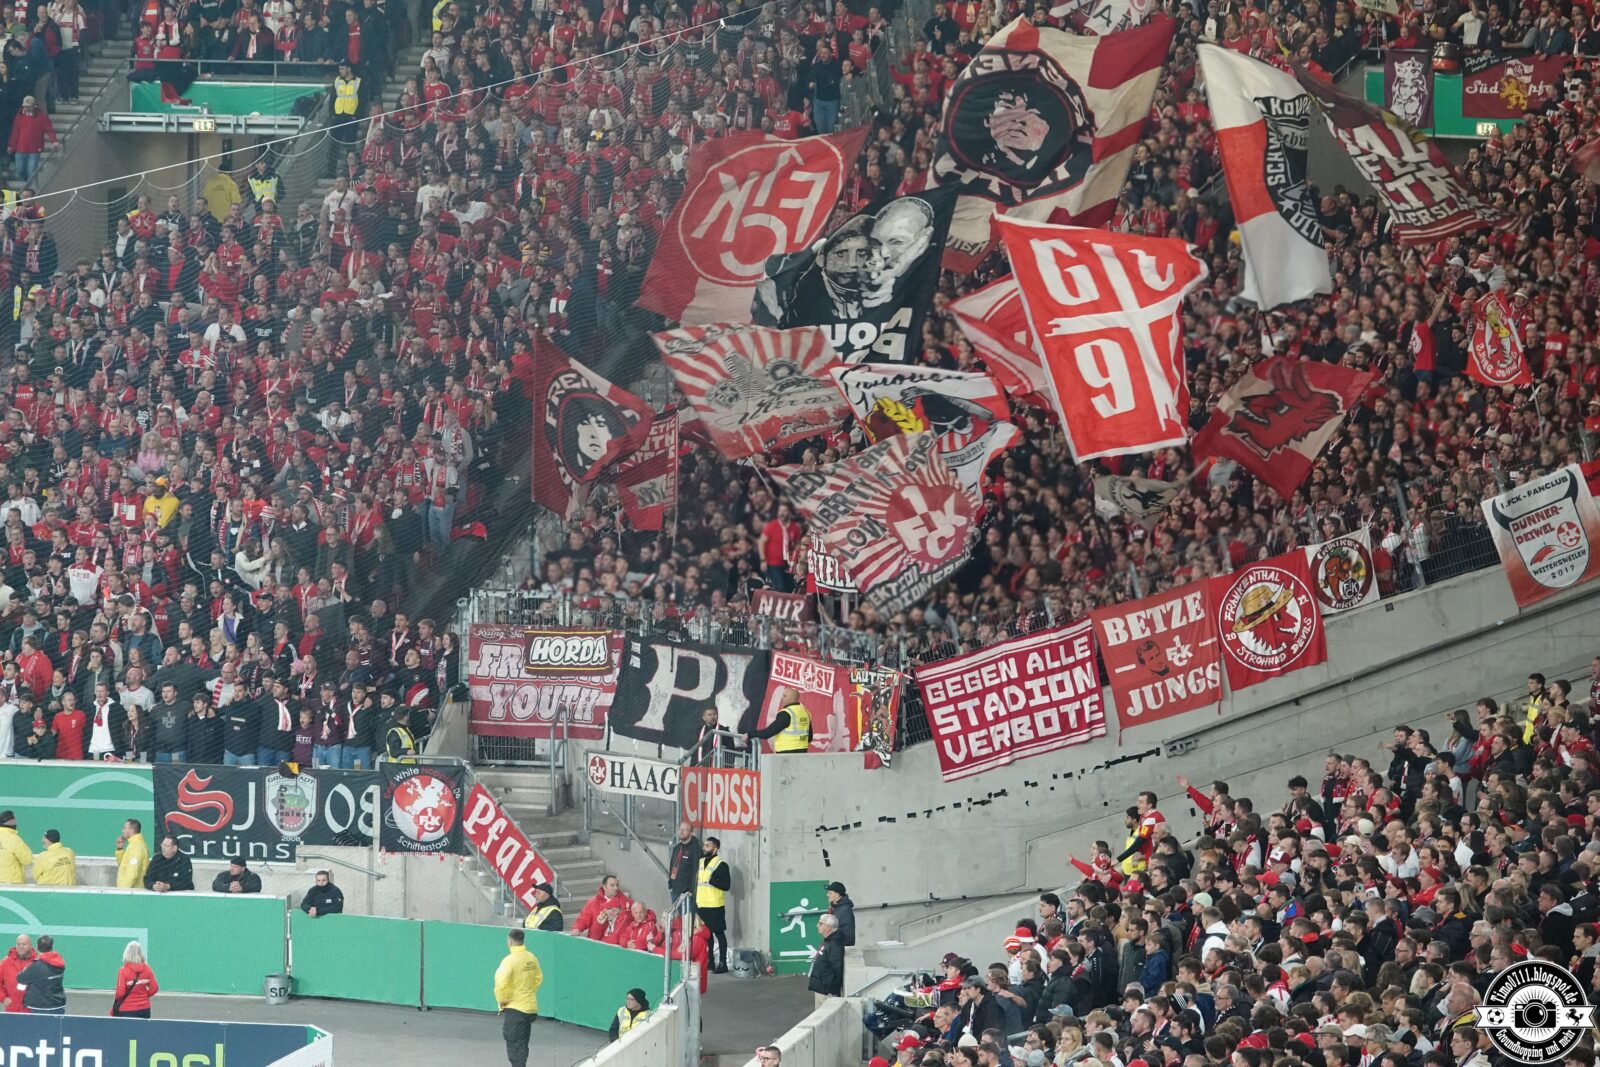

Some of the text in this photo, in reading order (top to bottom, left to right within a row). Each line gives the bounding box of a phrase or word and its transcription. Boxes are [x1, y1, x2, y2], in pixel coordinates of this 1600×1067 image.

[1465, 80, 1500, 94] Süd
[1550, 565, 1576, 580] 2017
[758, 594, 808, 620] NUR
[1223, 569, 1281, 622] FRANKENTHAL
[1101, 590, 1206, 647] BETZE
[1225, 631, 1237, 642] 20
[1291, 616, 1312, 654] DEVILS
[530, 636, 608, 666] HORDA
[774, 656, 835, 691] SEK SV
[925, 635, 1092, 706] GEGEN ALLE
[488, 682, 602, 724] YOUTH
[931, 661, 1097, 736] STADION
[1126, 660, 1221, 718] JUNGS
[943, 693, 1104, 764] VERBOTE
[393, 767, 420, 783] White
[609, 760, 680, 796] HAAG
[684, 771, 759, 826] CHRISSI
[177, 833, 306, 861] Grüns
[396, 835, 451, 852] Schifferstadt
